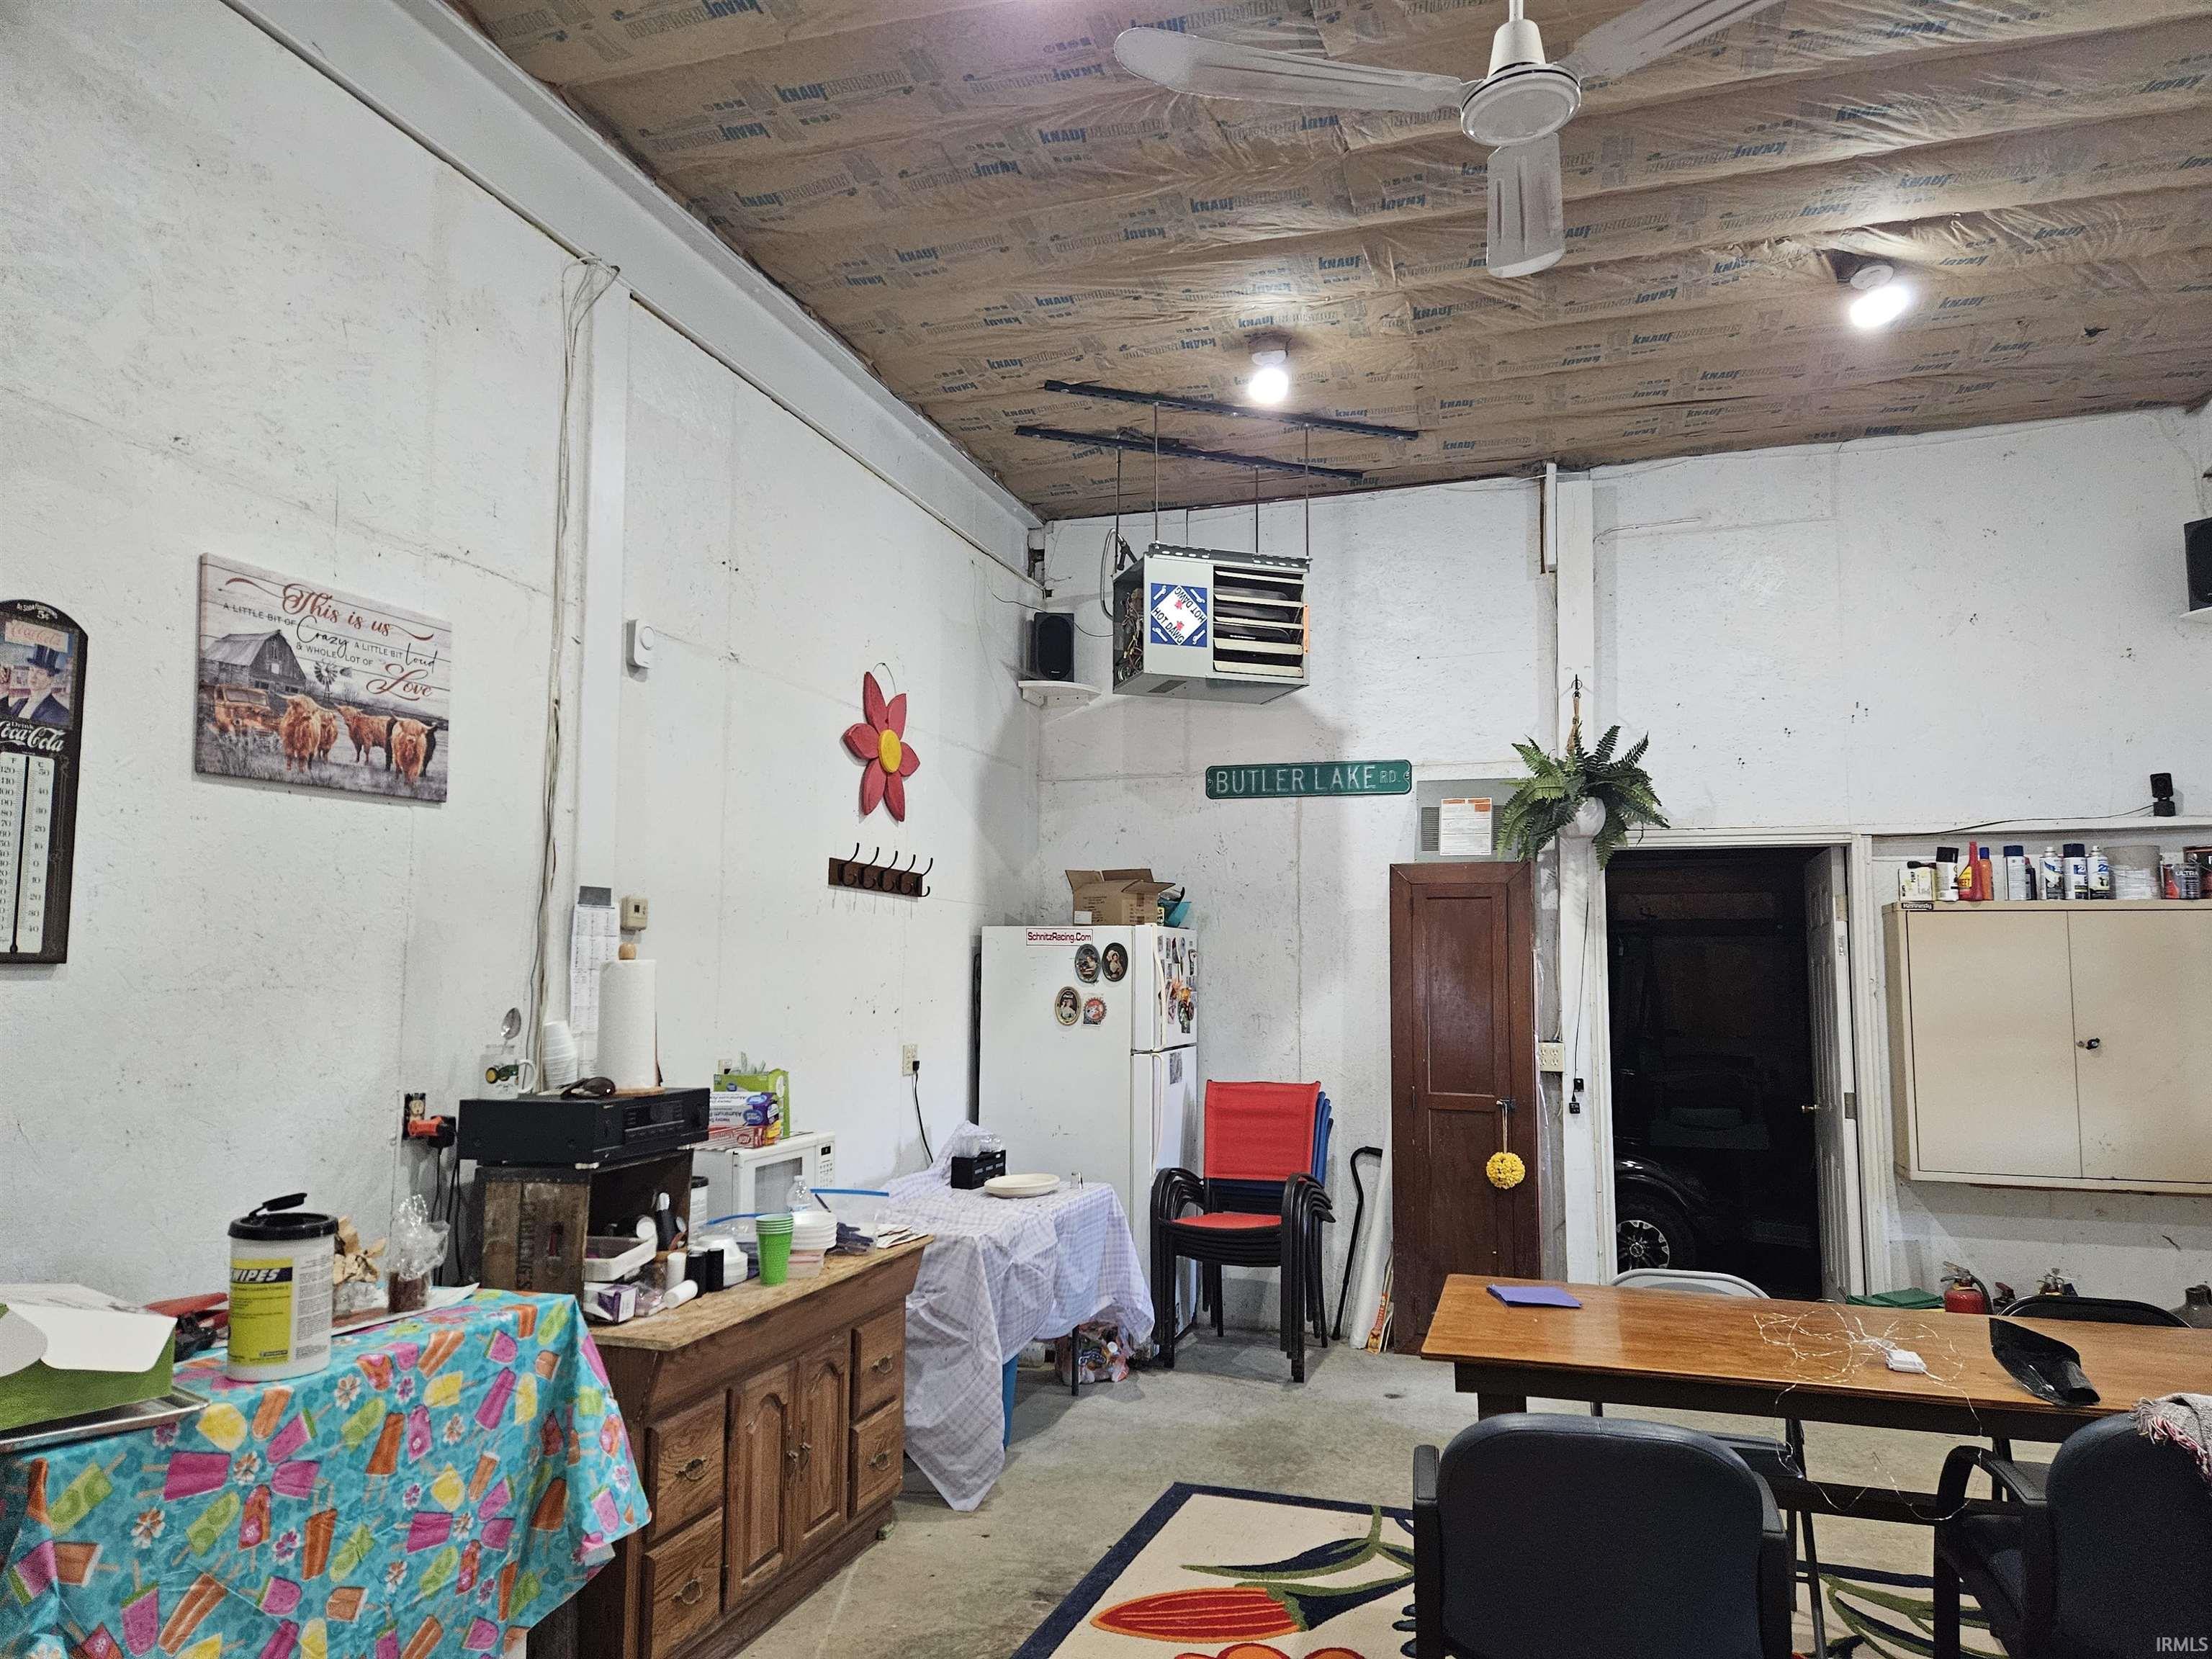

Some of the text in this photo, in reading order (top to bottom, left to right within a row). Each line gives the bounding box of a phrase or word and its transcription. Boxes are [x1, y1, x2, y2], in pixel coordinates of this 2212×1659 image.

[282, 583, 394, 637] This is us
[1174, 587, 1206, 623] HOT DAWG
[222, 602, 230, 611] A
[233, 604, 265, 620] LITTLE
[267, 613, 282, 624] BIT
[284, 618, 297, 627] OF
[296, 615, 349, 659] Crazy
[361, 644, 389, 657] LITTLE
[390, 649, 404, 660] BIT
[1152, 607, 1184, 644] HOT DAWG
[295, 642, 433, 702] & WHOLE LOT OF Love
[1215, 764, 1401, 794] BUTLER LAKE RD.
[1028, 931, 1092, 943] SchnitzRacing.Com
